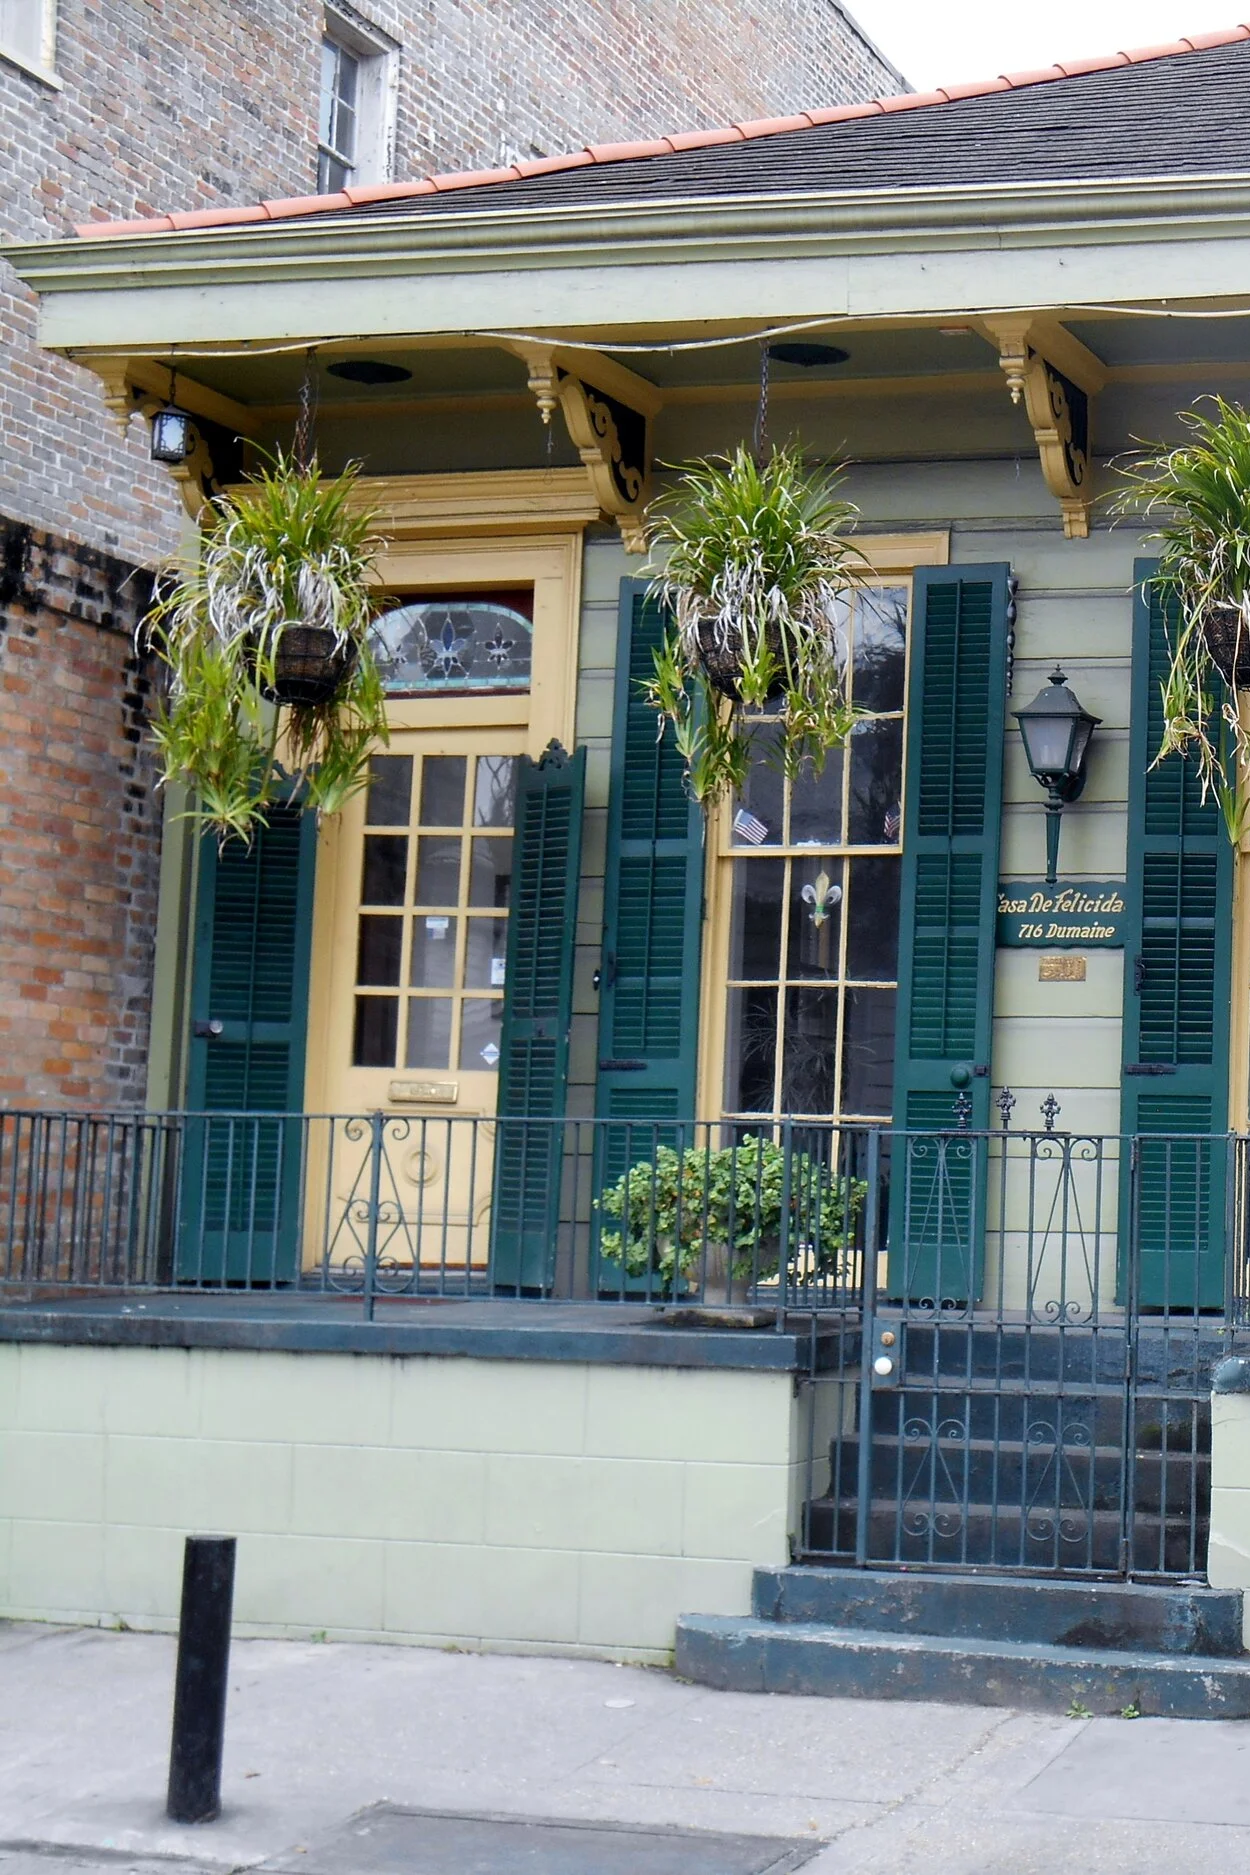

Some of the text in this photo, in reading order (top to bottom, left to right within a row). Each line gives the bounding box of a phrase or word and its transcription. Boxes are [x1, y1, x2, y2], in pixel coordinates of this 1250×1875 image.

[997, 888, 1127, 913] asa De Felicida
[1018, 921, 1116, 938] 716 Dumaine
